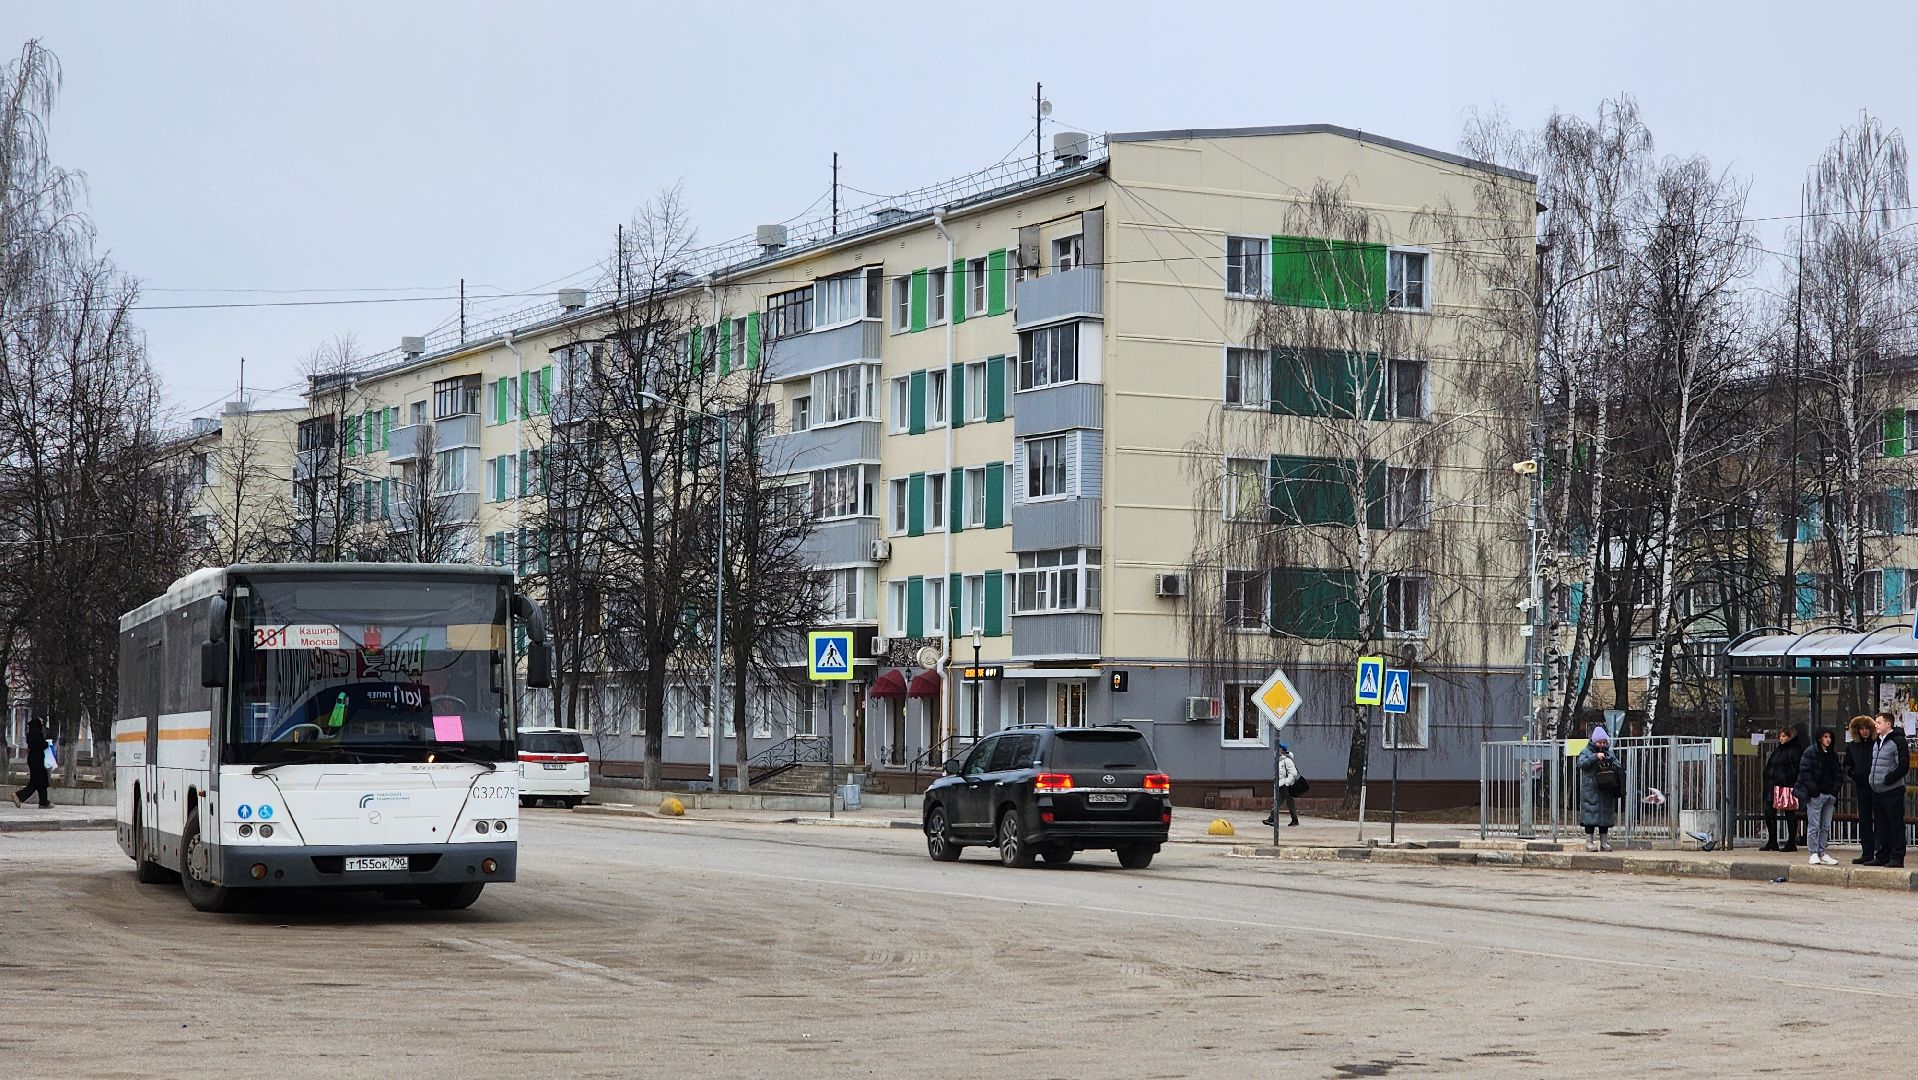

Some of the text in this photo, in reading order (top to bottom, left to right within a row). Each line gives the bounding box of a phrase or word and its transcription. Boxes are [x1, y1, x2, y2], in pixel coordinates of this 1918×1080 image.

[255, 626, 338, 648] 381 Кашира
[301, 638, 338, 646] Москва
